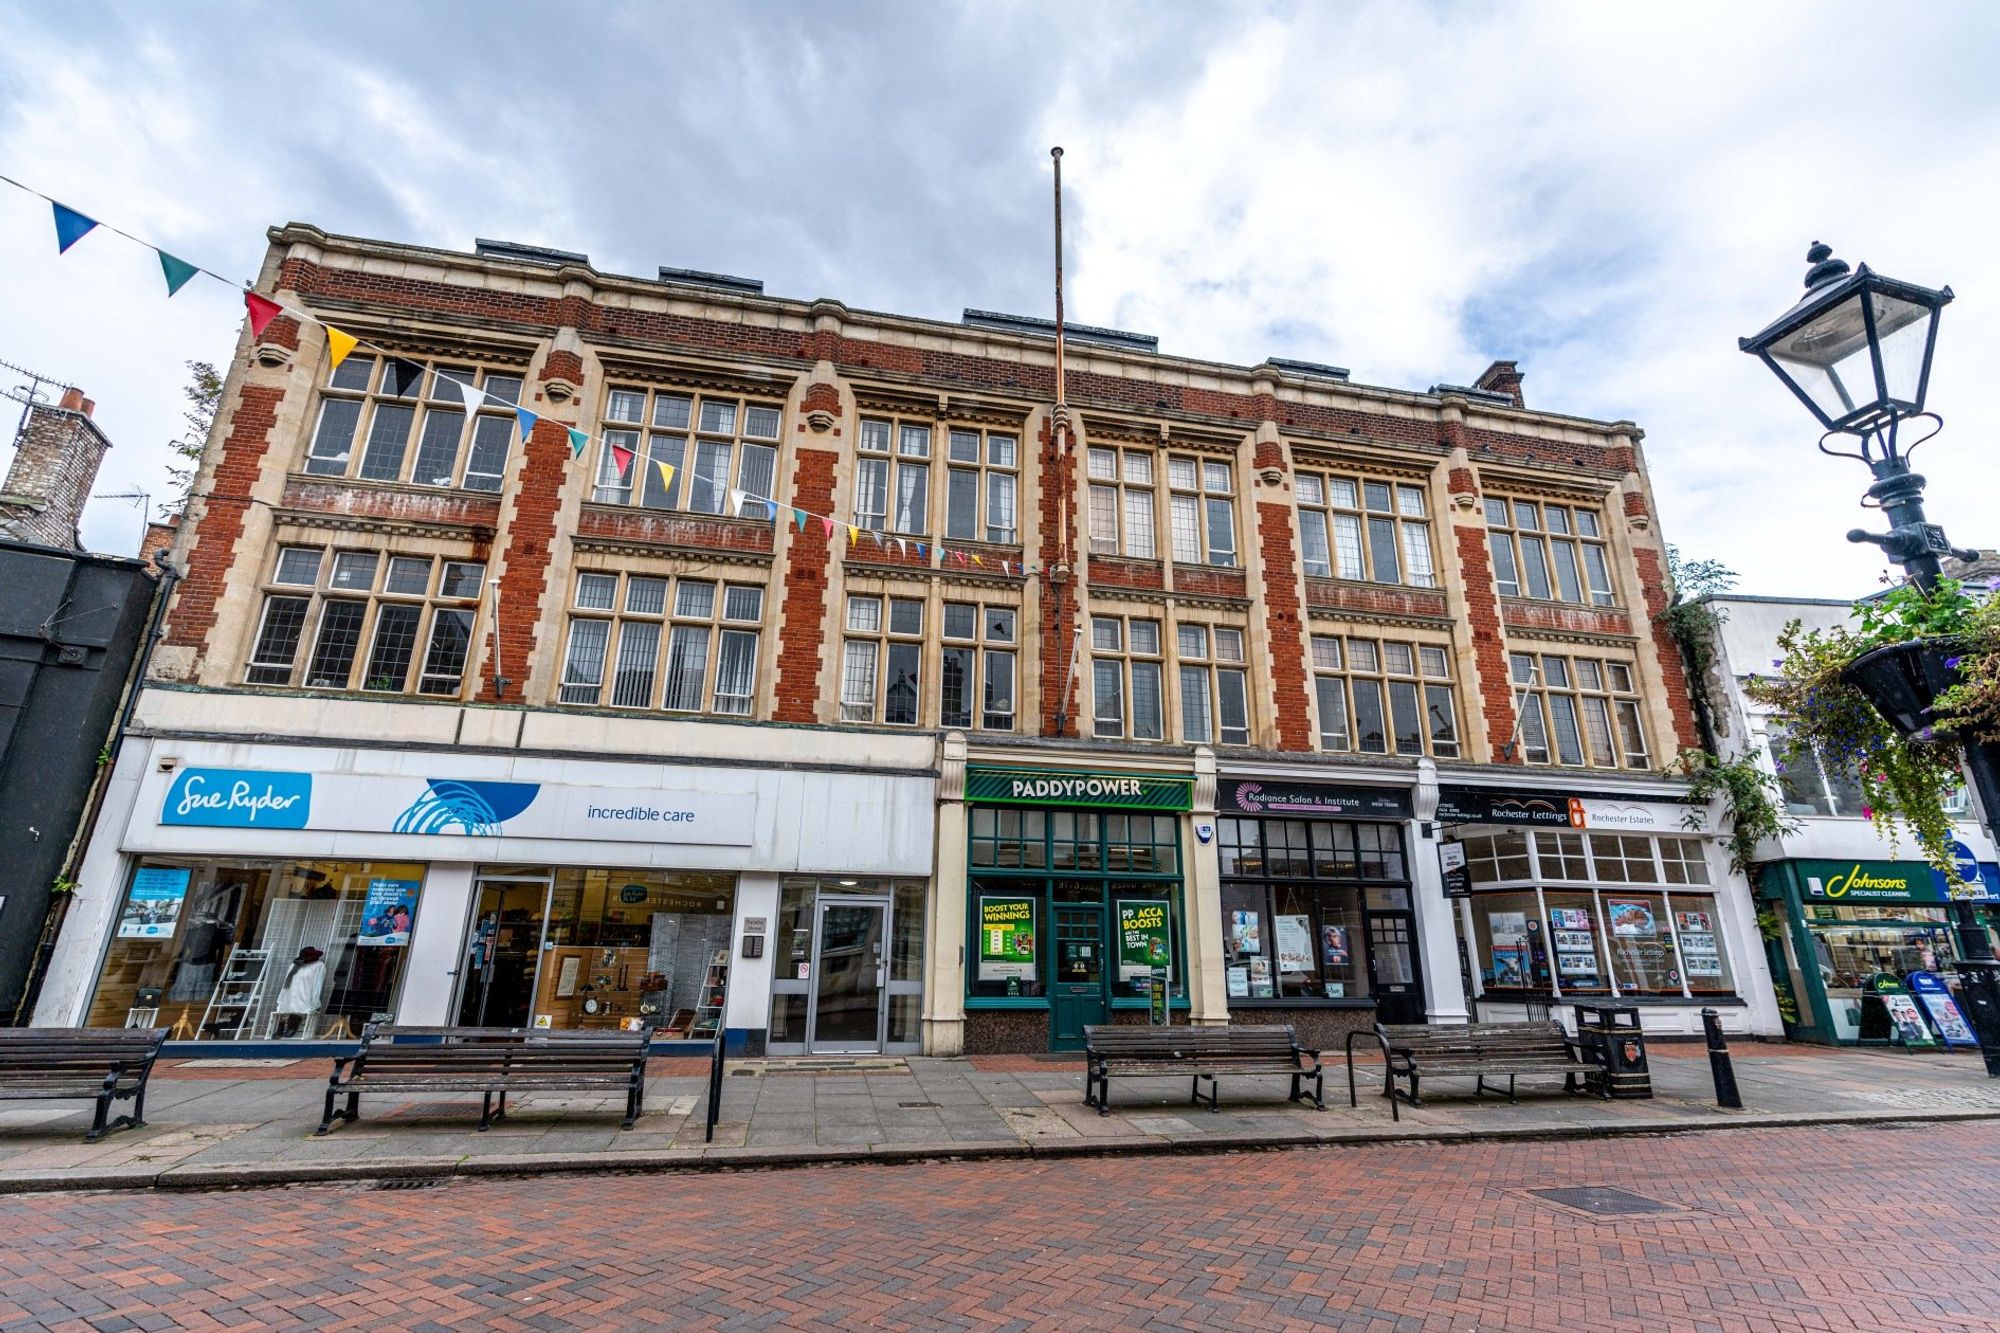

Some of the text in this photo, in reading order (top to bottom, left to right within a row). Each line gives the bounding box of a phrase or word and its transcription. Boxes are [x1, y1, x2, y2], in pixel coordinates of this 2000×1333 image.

[177, 776, 300, 821] Sue Ryder
[1248, 792, 1360, 807] Radiance Salon & Institute
[587, 804, 695, 823] incredible care
[1491, 808, 1529, 819] Rochester
[1532, 810, 1567, 822] Lettings
[1592, 813, 1628, 823] Rochester
[1629, 815, 1655, 825] Estates
[1826, 864, 1907, 898] Johnsons
[1850, 889, 1911, 898] SPECIALIST CLEANING
[984, 903, 1029, 913] BOOST YOUR
[1138, 907, 1164, 918] ACCA
[984, 910, 1030, 921] WINNINGS
[1123, 917, 1162, 930] BOOSTS
[1126, 940, 1148, 949] TOWN
